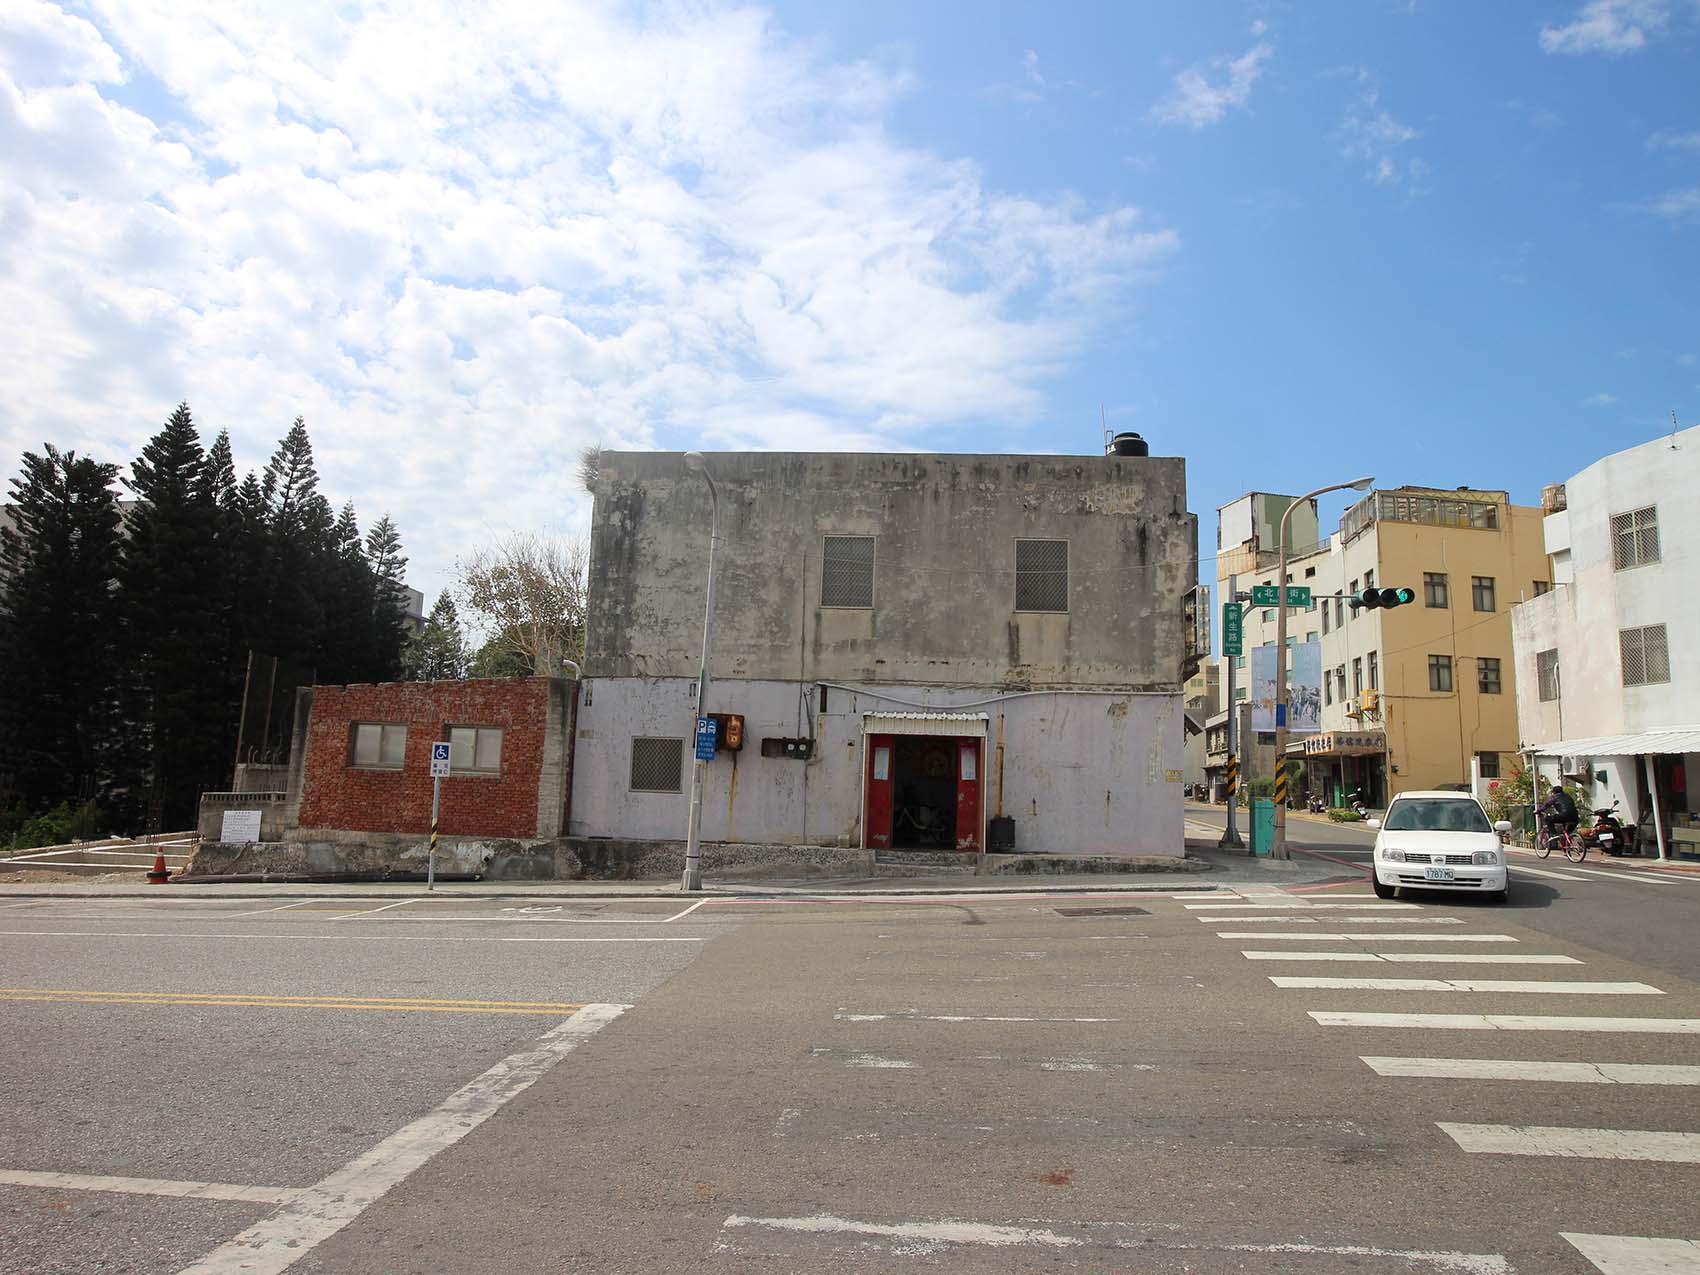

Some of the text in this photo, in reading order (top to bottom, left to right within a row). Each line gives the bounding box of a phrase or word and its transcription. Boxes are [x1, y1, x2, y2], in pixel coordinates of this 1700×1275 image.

[1264, 588, 1299, 598] 北街
[1228, 611, 1238, 642] 新生路
[699, 722, 705, 732] P
